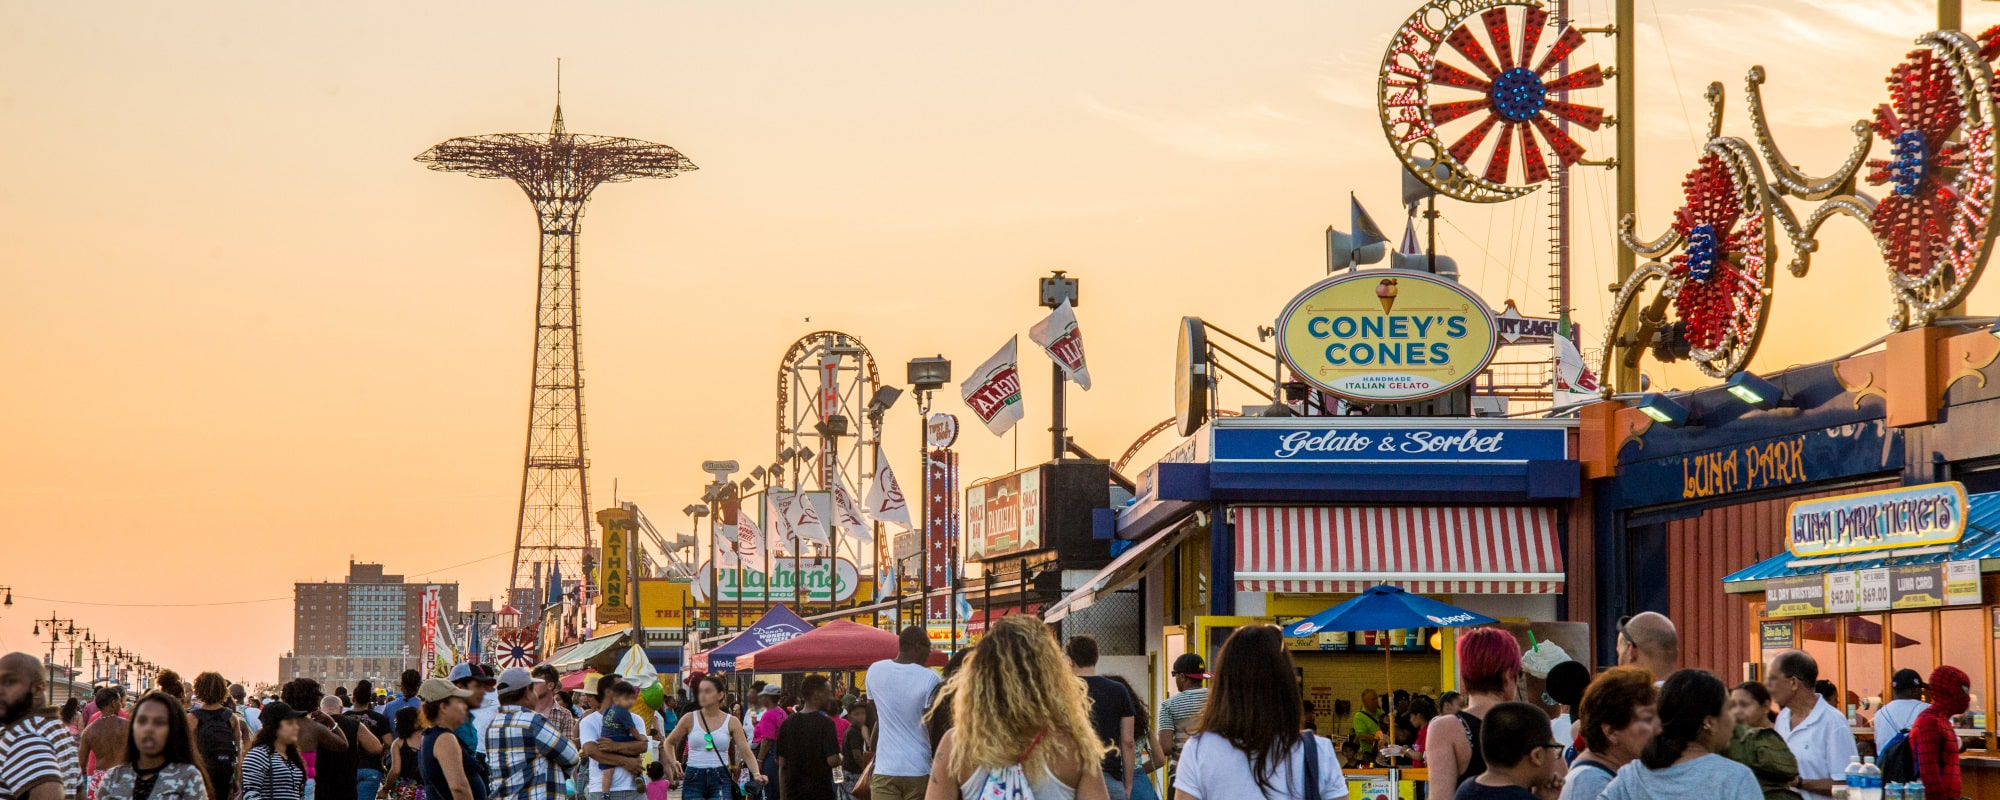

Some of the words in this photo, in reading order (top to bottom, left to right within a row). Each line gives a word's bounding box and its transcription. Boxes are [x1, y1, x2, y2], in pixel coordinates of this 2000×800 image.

[1308, 315, 1468, 339] CONEY'S
[1325, 342, 1451, 366] CONES
[1345, 382, 1386, 390] ITALIAN
[1389, 382, 1430, 390] GELATO
[1275, 429, 1373, 458] Gelato
[1377, 433, 1397, 452] &
[1400, 429, 1504, 454] Sorbet
[1682, 449, 1738, 499] LUNA
[1745, 437, 1807, 491] PARK
[1792, 511, 1832, 545] LUNA
[1836, 504, 1880, 544] PARK
[1882, 494, 1950, 535] TICKETS
[607, 519, 621, 607] NATHANS
[719, 561, 846, 593] Nahan's
[1897, 578, 1914, 591] LUNA
[1915, 576, 1933, 590] CARD
[1791, 585, 1823, 600] WRISTBAND
[1831, 589, 1854, 606] $42.00
[1863, 587, 1888, 604] $69.00
[656, 610, 680, 618] THE
[713, 660, 736, 668] Welco
